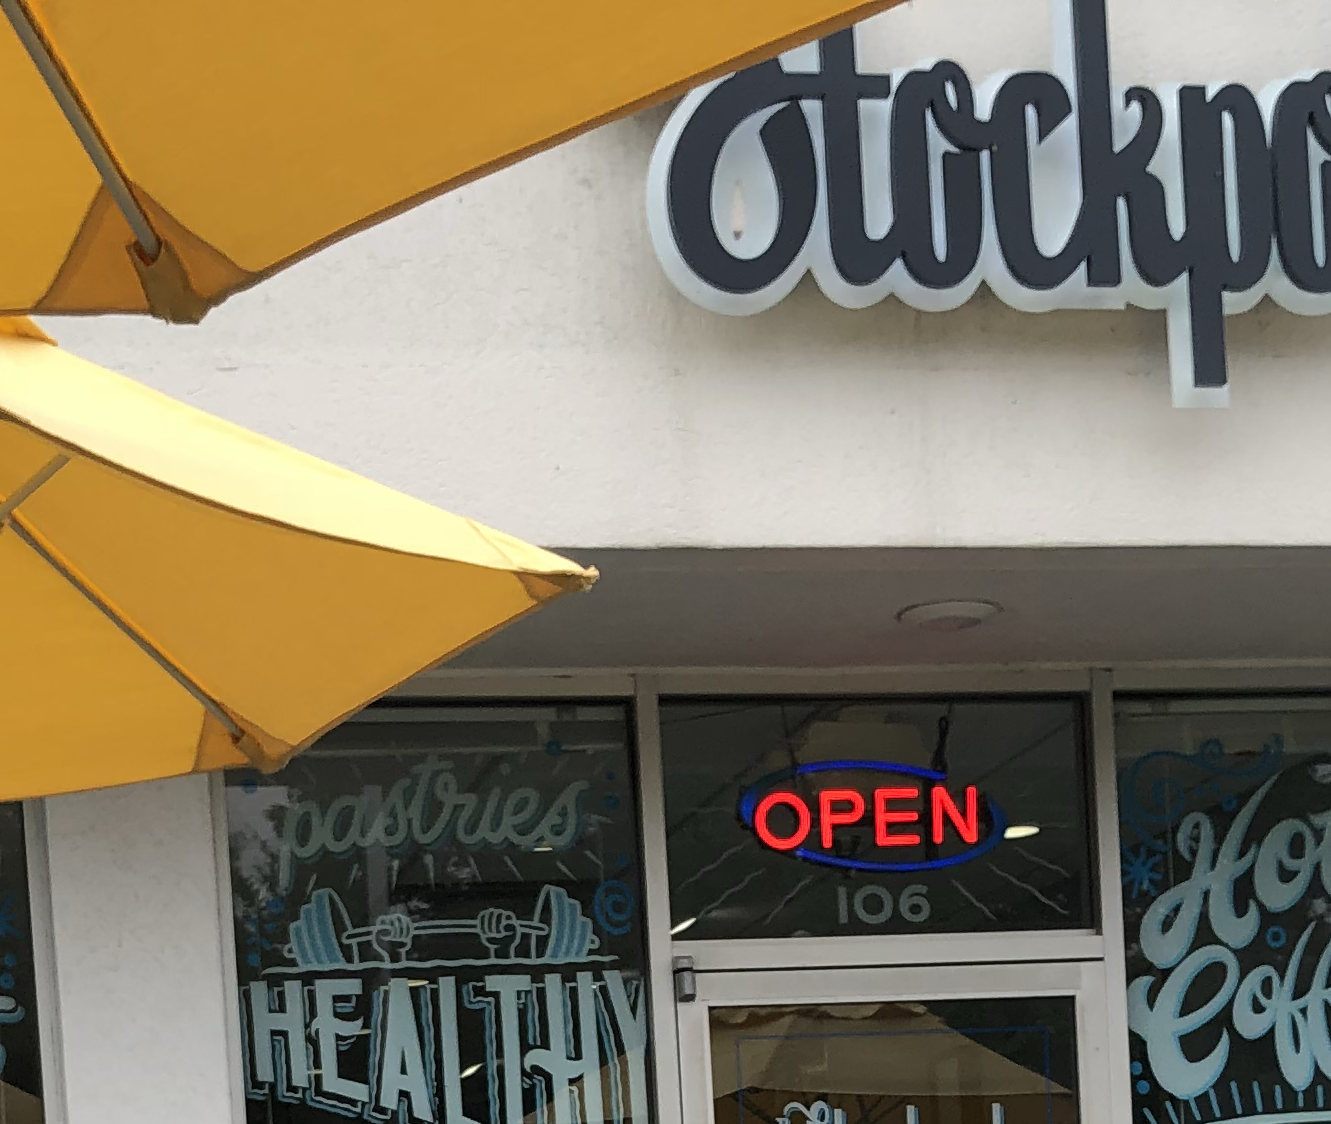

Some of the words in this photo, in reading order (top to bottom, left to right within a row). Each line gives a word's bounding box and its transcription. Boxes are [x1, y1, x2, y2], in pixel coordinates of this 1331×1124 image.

[276, 758, 590, 893] pastries
[755, 785, 980, 850] OPEN
[837, 884, 931, 924] 106
